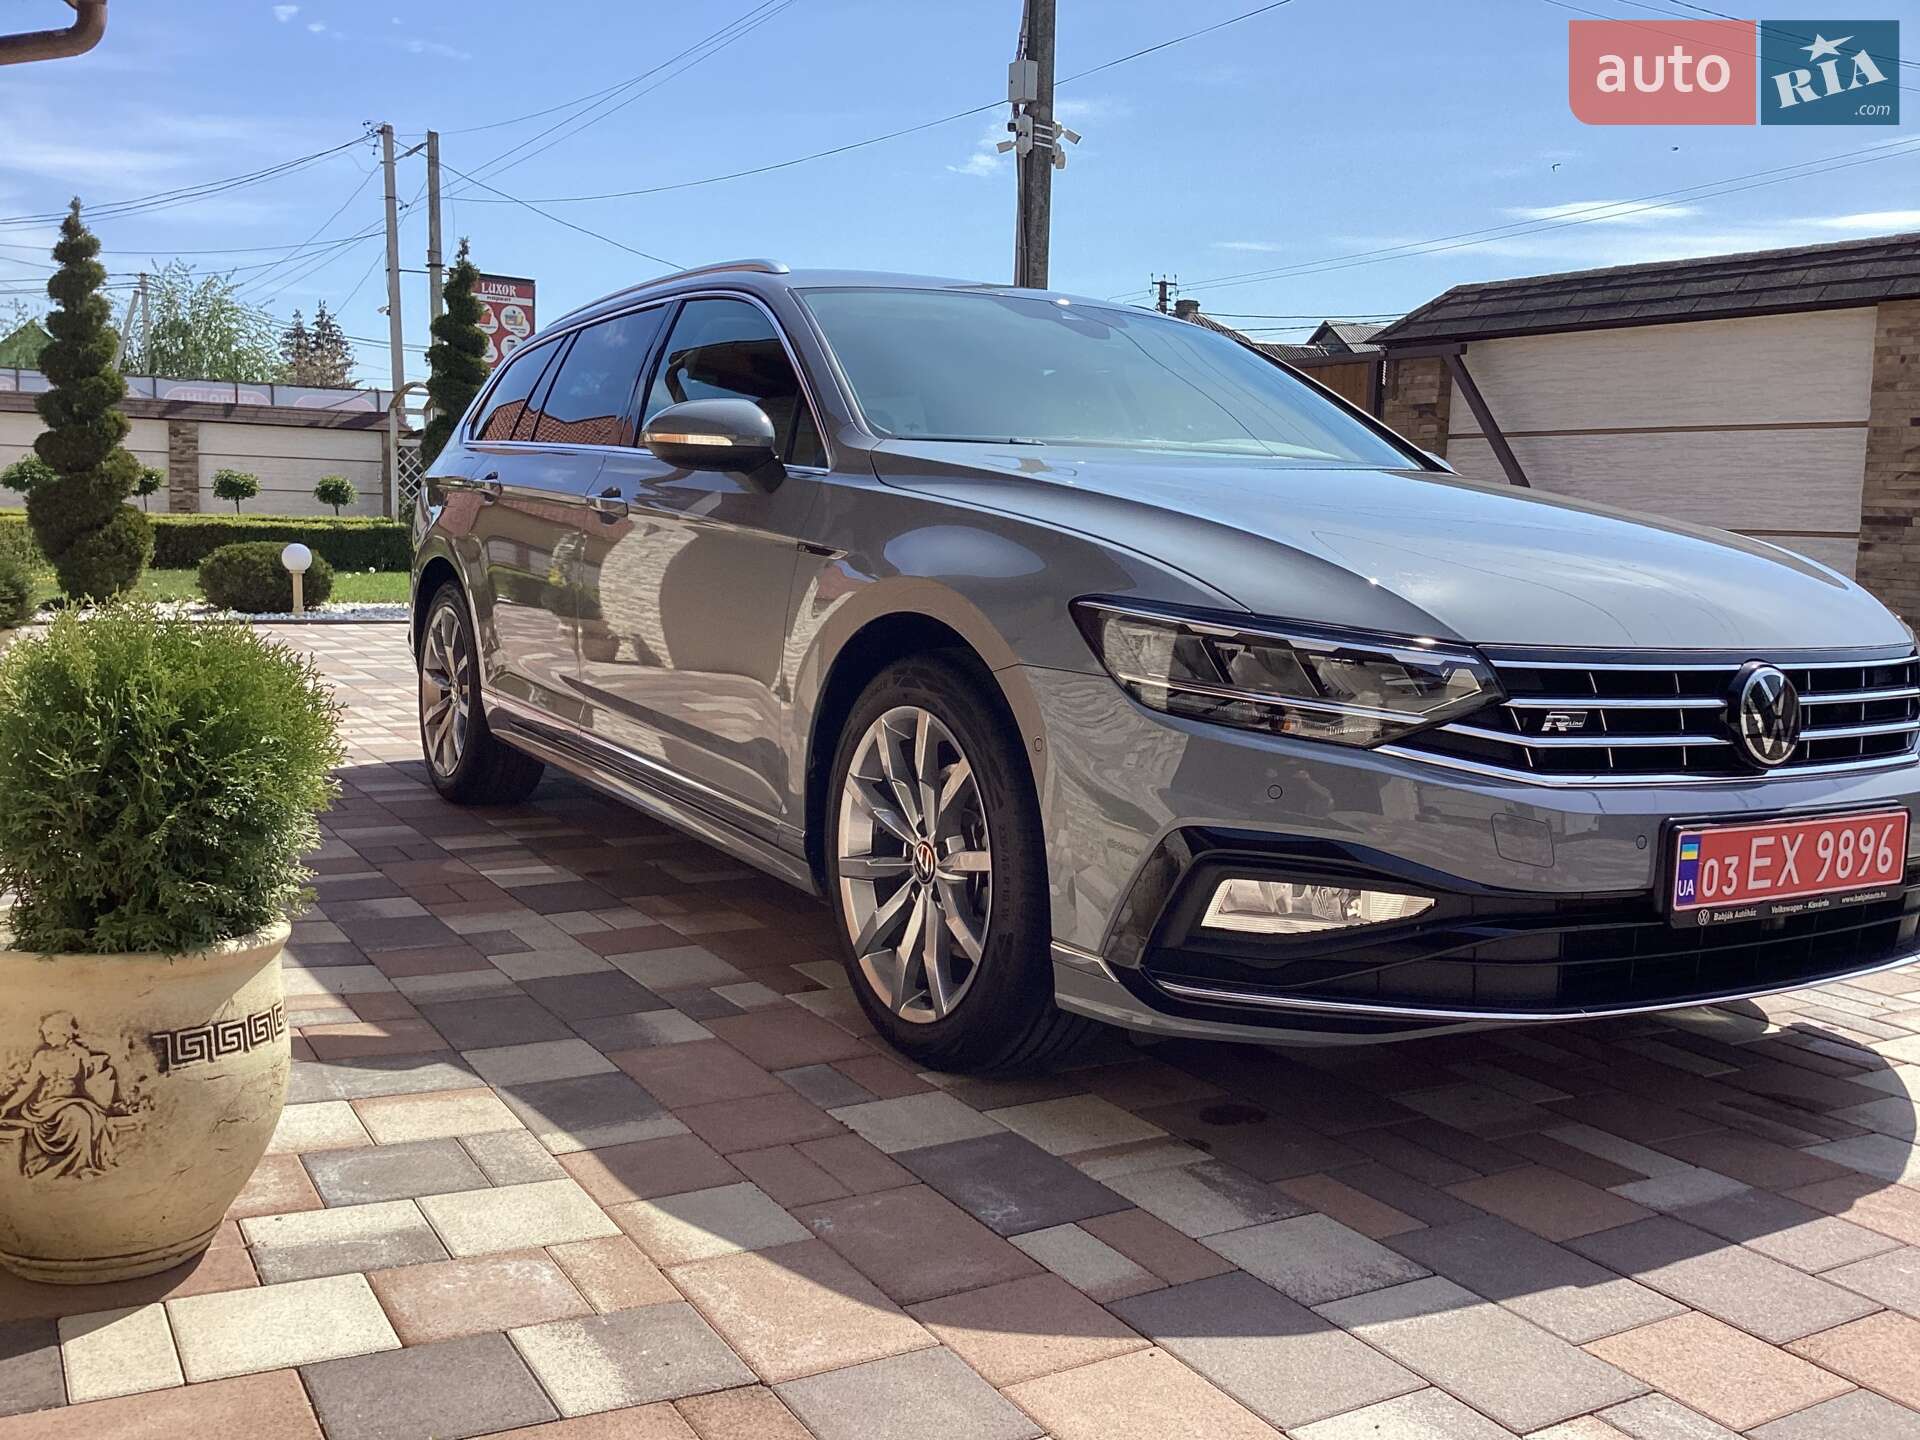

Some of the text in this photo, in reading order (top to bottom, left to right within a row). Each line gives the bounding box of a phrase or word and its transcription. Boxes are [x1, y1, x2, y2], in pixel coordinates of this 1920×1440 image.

[481, 282, 517, 297] LUXOR
[1700, 823, 1894, 897] 03 EX 9896
[1678, 878, 1695, 897] UA
[1771, 902, 1803, 914] Volkswagen
